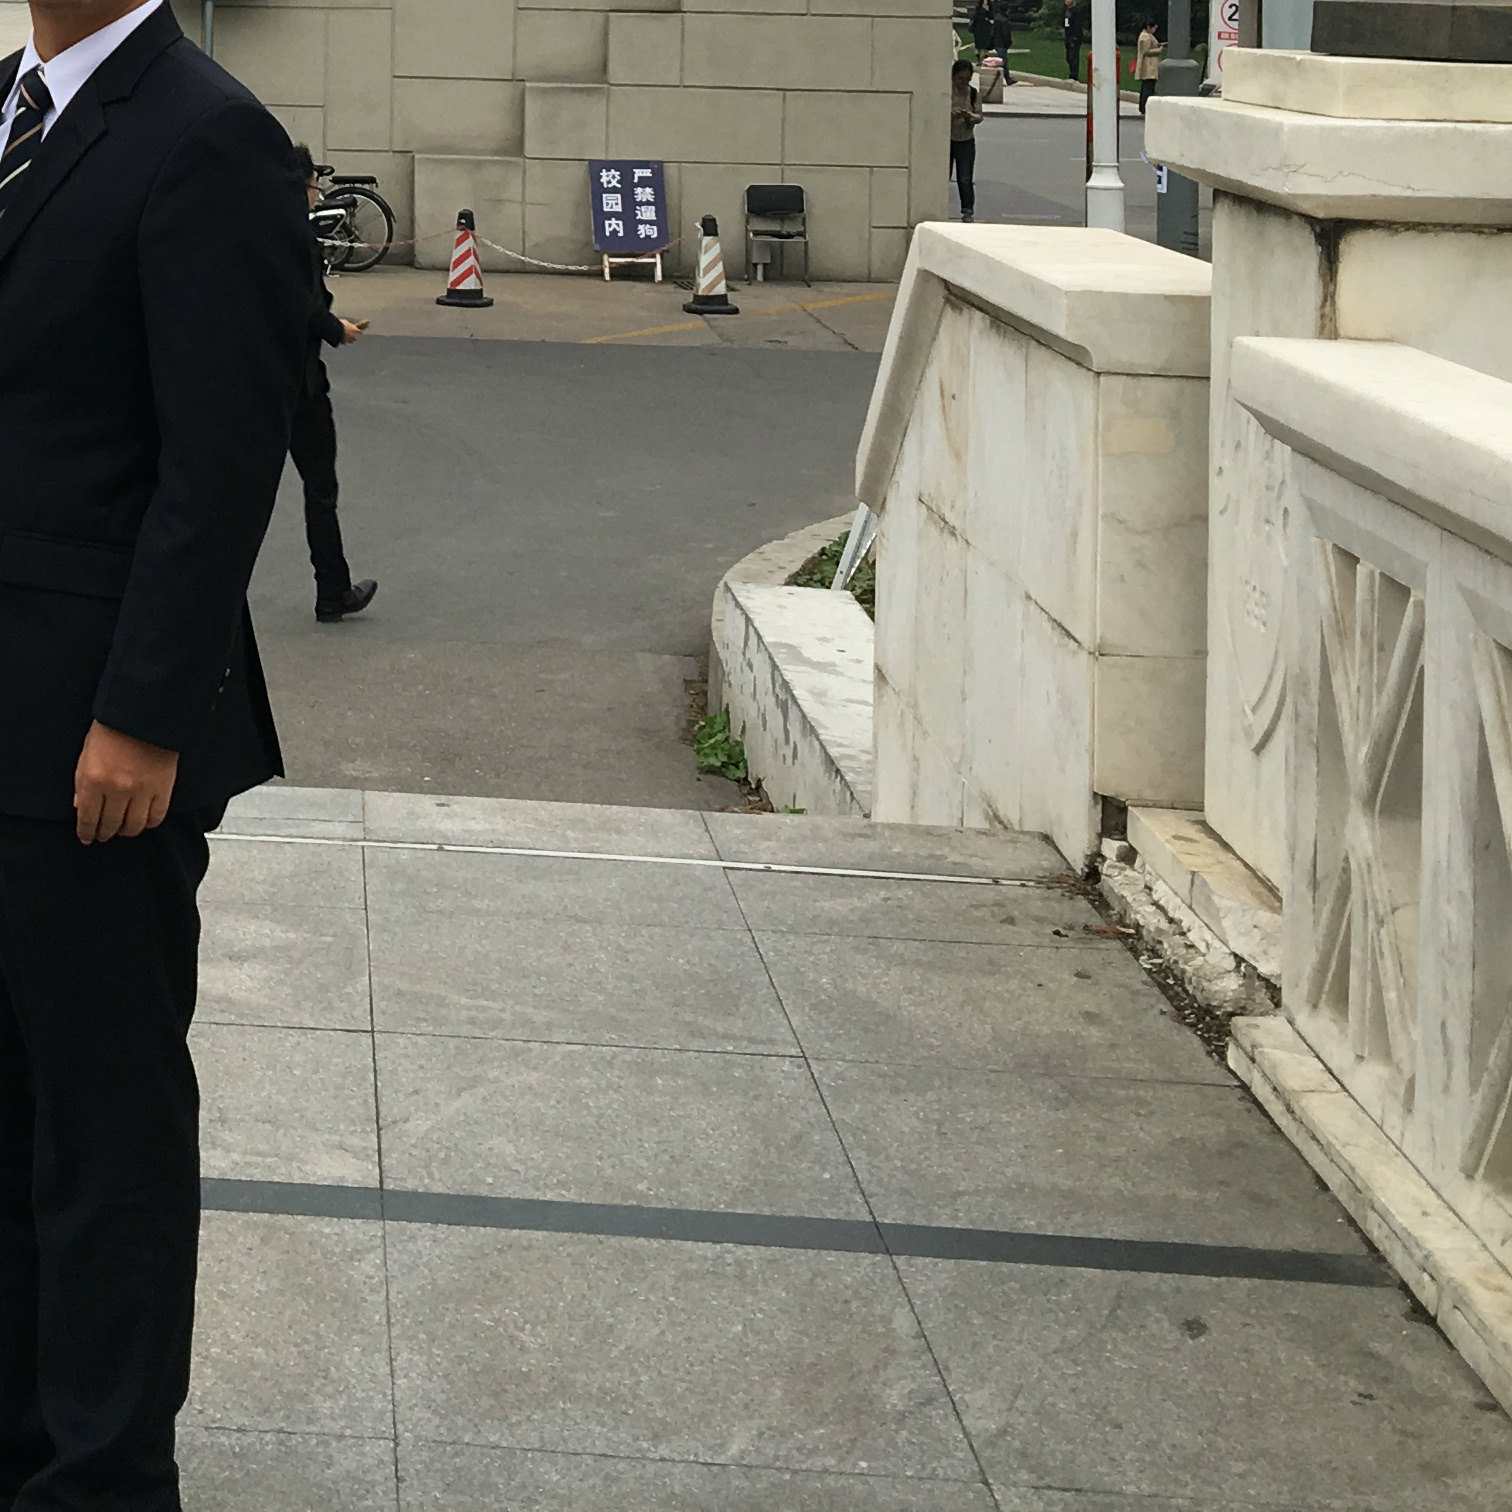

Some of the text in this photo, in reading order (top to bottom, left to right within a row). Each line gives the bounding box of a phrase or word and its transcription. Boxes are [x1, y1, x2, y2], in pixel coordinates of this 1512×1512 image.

[599, 168, 625, 238] 校园内
[632, 168, 658, 239] 严禁遛狗
